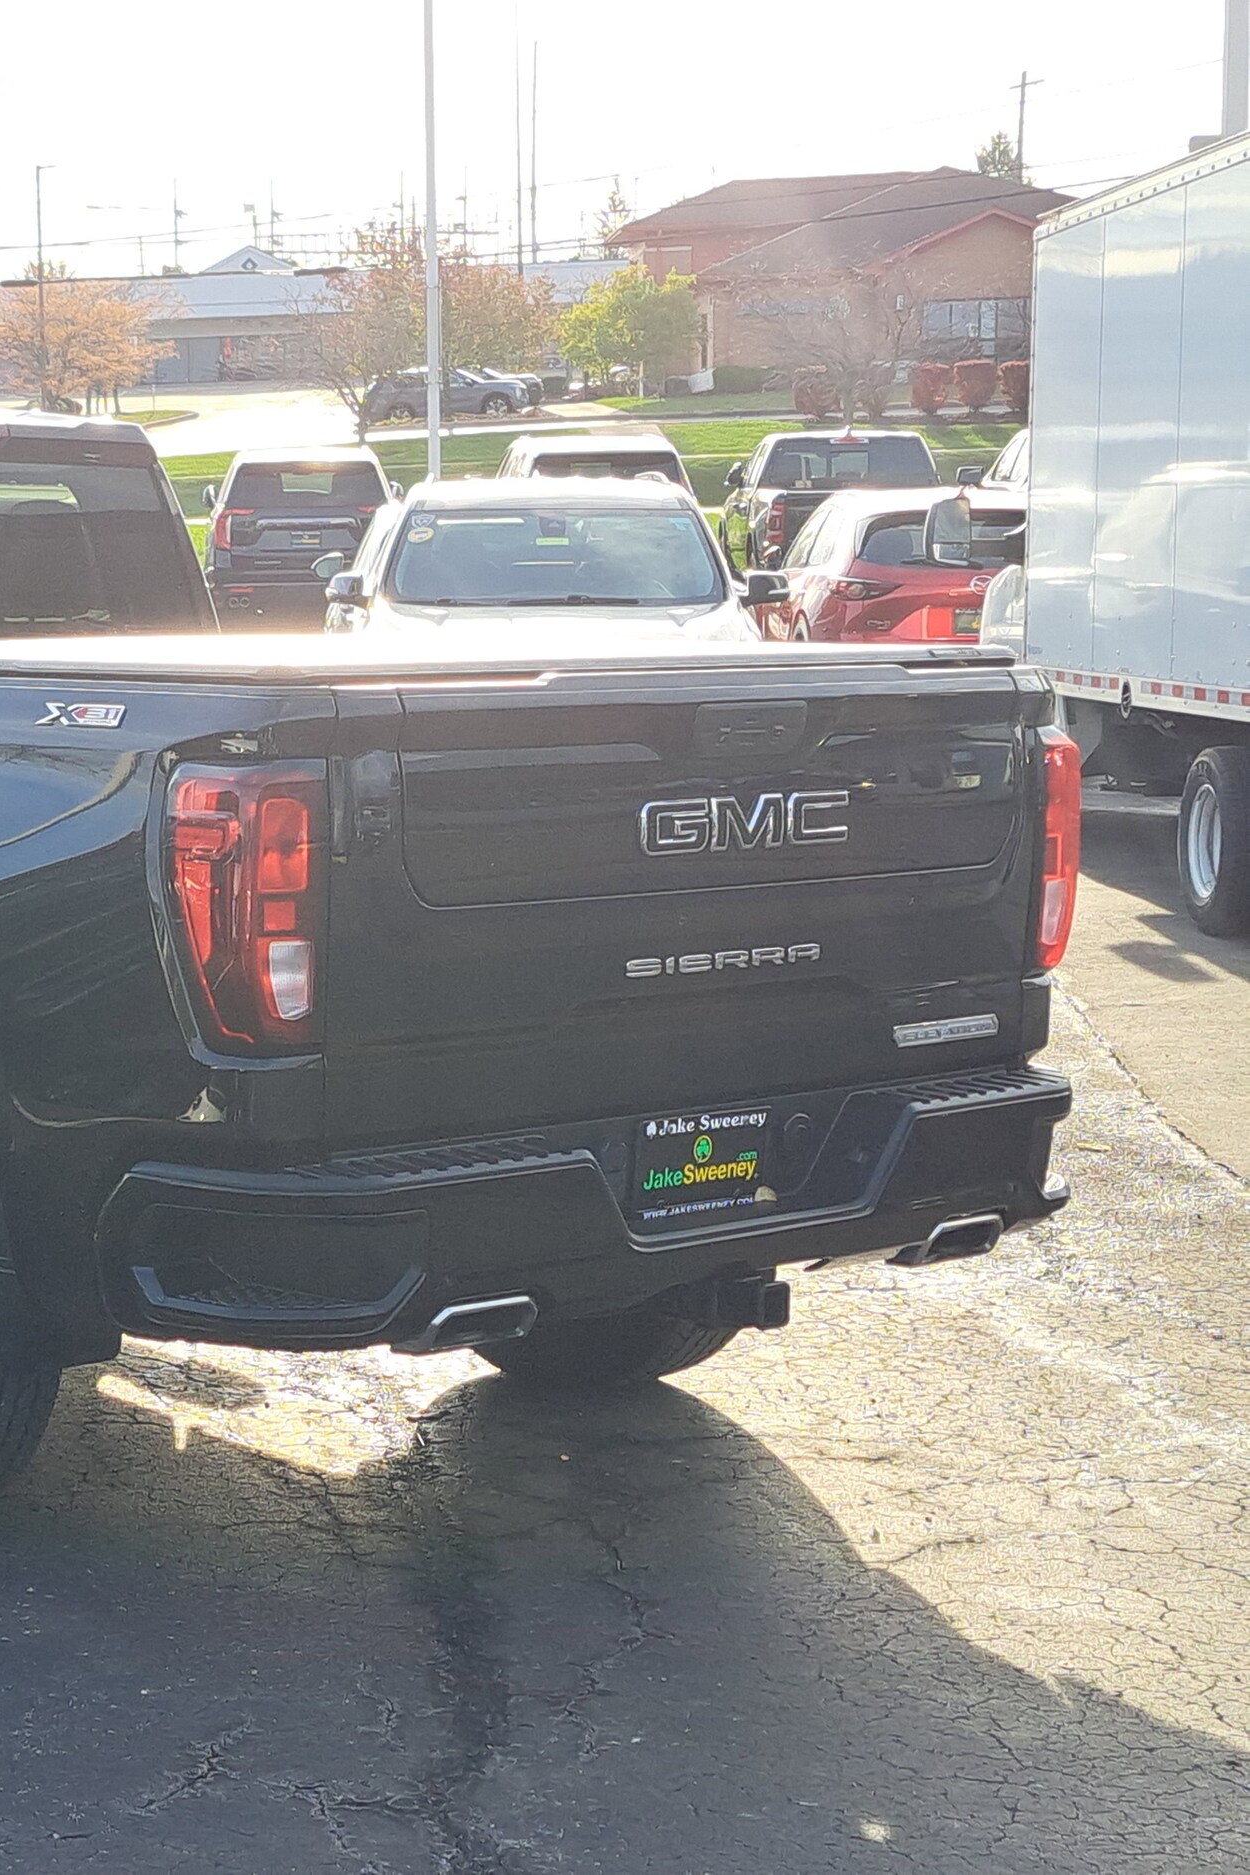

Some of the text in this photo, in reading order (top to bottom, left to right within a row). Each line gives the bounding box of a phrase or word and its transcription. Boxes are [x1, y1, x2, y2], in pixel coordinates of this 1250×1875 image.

[640, 790, 849, 856] GMC
[625, 943, 821, 978] SIERRA
[659, 1112, 767, 1136] Jake Sweeney
